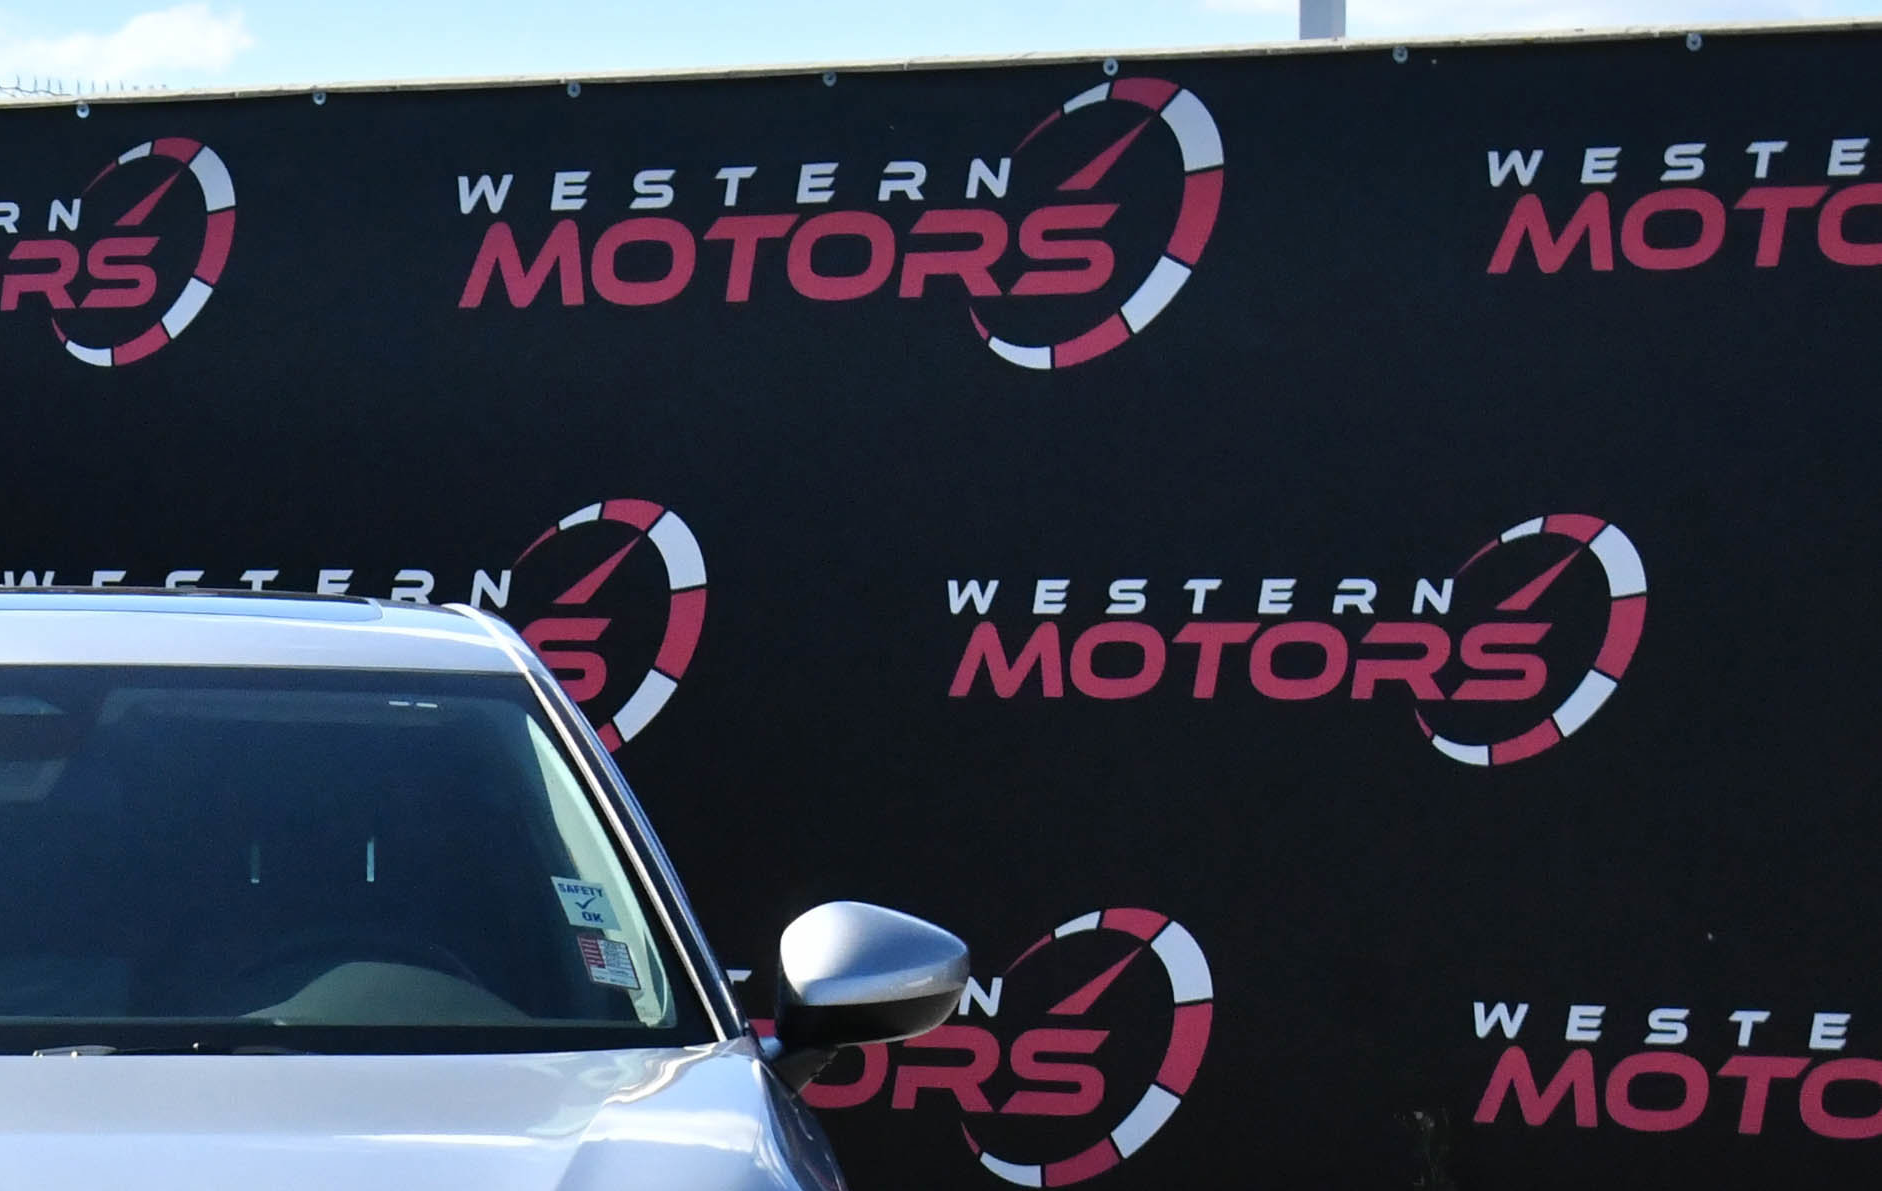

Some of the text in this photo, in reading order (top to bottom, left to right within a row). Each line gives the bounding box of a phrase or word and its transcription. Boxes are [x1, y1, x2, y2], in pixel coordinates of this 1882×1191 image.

[457, 158, 1011, 214] WESTERN
[1487, 138, 1870, 187] WESTE
[458, 203, 1119, 309] MOTORS
[947, 578, 1455, 616] WESTERN
[948, 620, 1554, 702] MOTORS
[558, 883, 604, 897] SAFETY
[582, 911, 604, 923] OK
[1473, 1002, 1852, 1050] WESTE
[1473, 1045, 1882, 1140] MOTO
